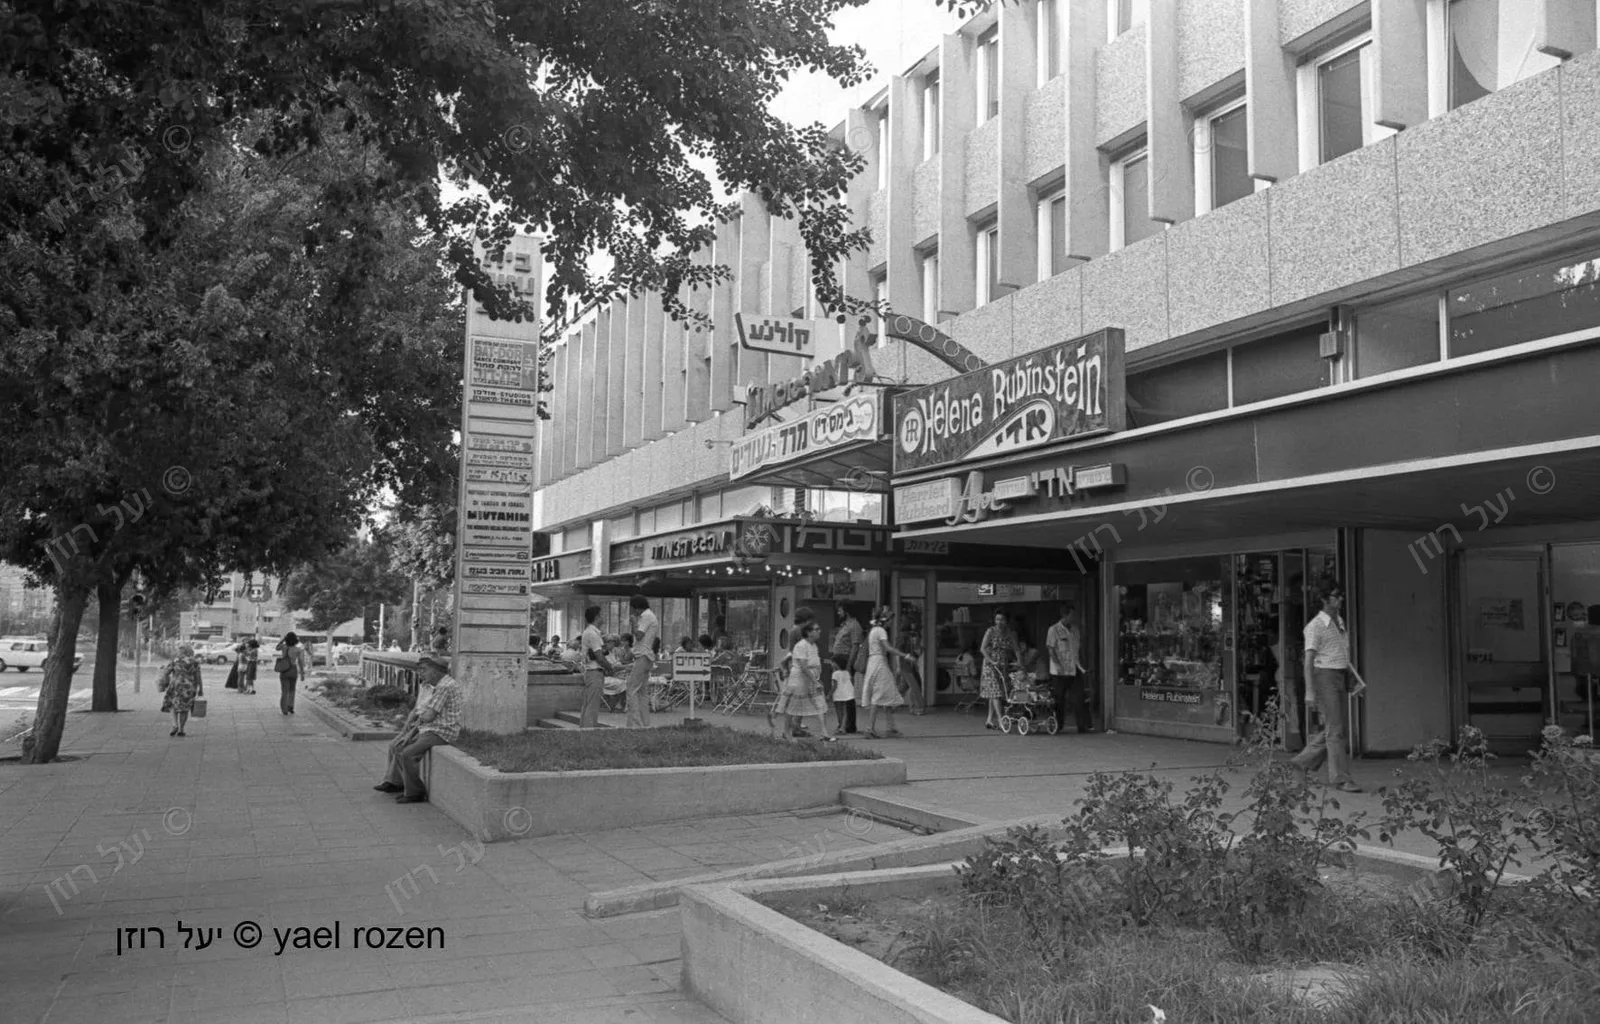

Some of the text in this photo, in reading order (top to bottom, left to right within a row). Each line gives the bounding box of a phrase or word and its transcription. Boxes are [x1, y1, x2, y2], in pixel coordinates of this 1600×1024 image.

[918, 387, 982, 456] Helena
[992, 344, 1102, 421] Rubinstein
[780, 421, 808, 455] מרד
[467, 510, 529, 521] MIVTAHIM
